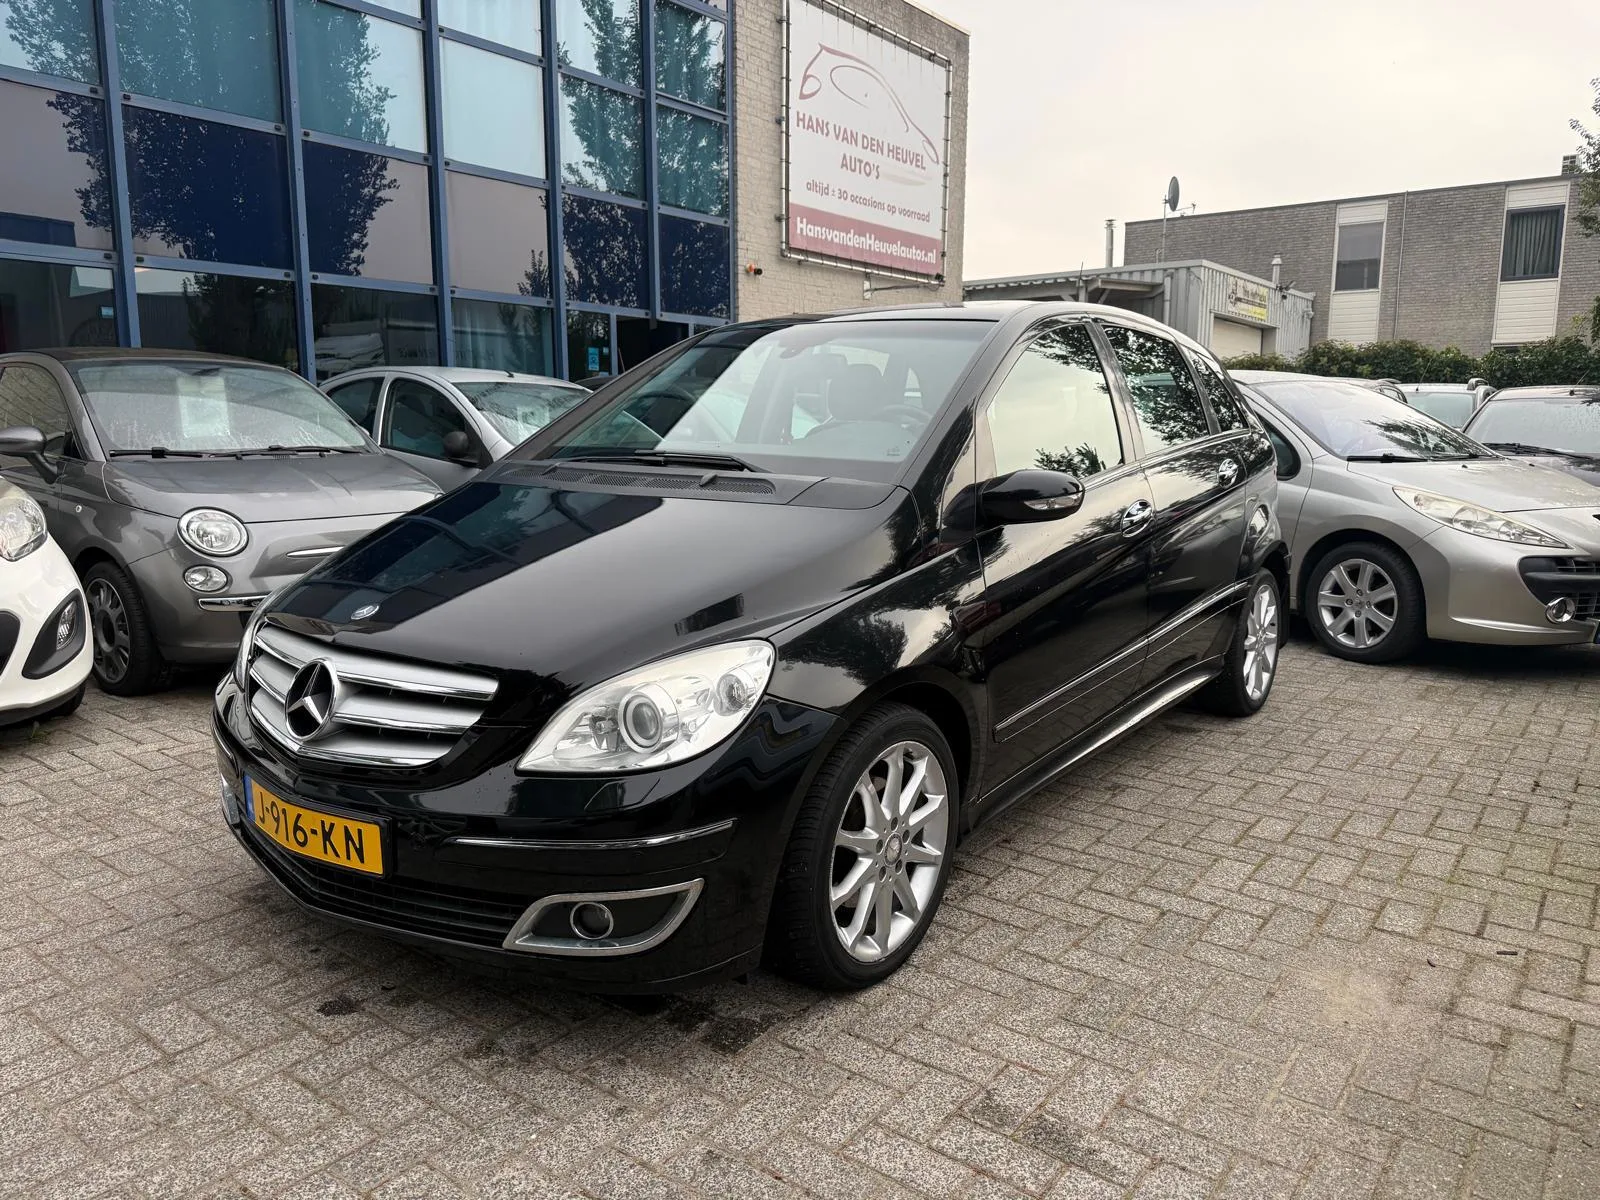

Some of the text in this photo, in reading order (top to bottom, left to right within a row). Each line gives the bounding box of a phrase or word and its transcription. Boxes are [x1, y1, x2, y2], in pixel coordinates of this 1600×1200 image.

[796, 111, 926, 170] HANS VAN DEN HEUVEL
[840, 153, 880, 179] AUTO'S
[806, 179, 829, 197] altijd
[838, 188, 848, 201] 30
[850, 193, 885, 211] occasions
[887, 203, 897, 216] op
[898, 207, 931, 223] voorraad
[796, 217, 936, 264] HansvandenHeuvelautos.nl
[259, 791, 365, 864] J-916-KN
